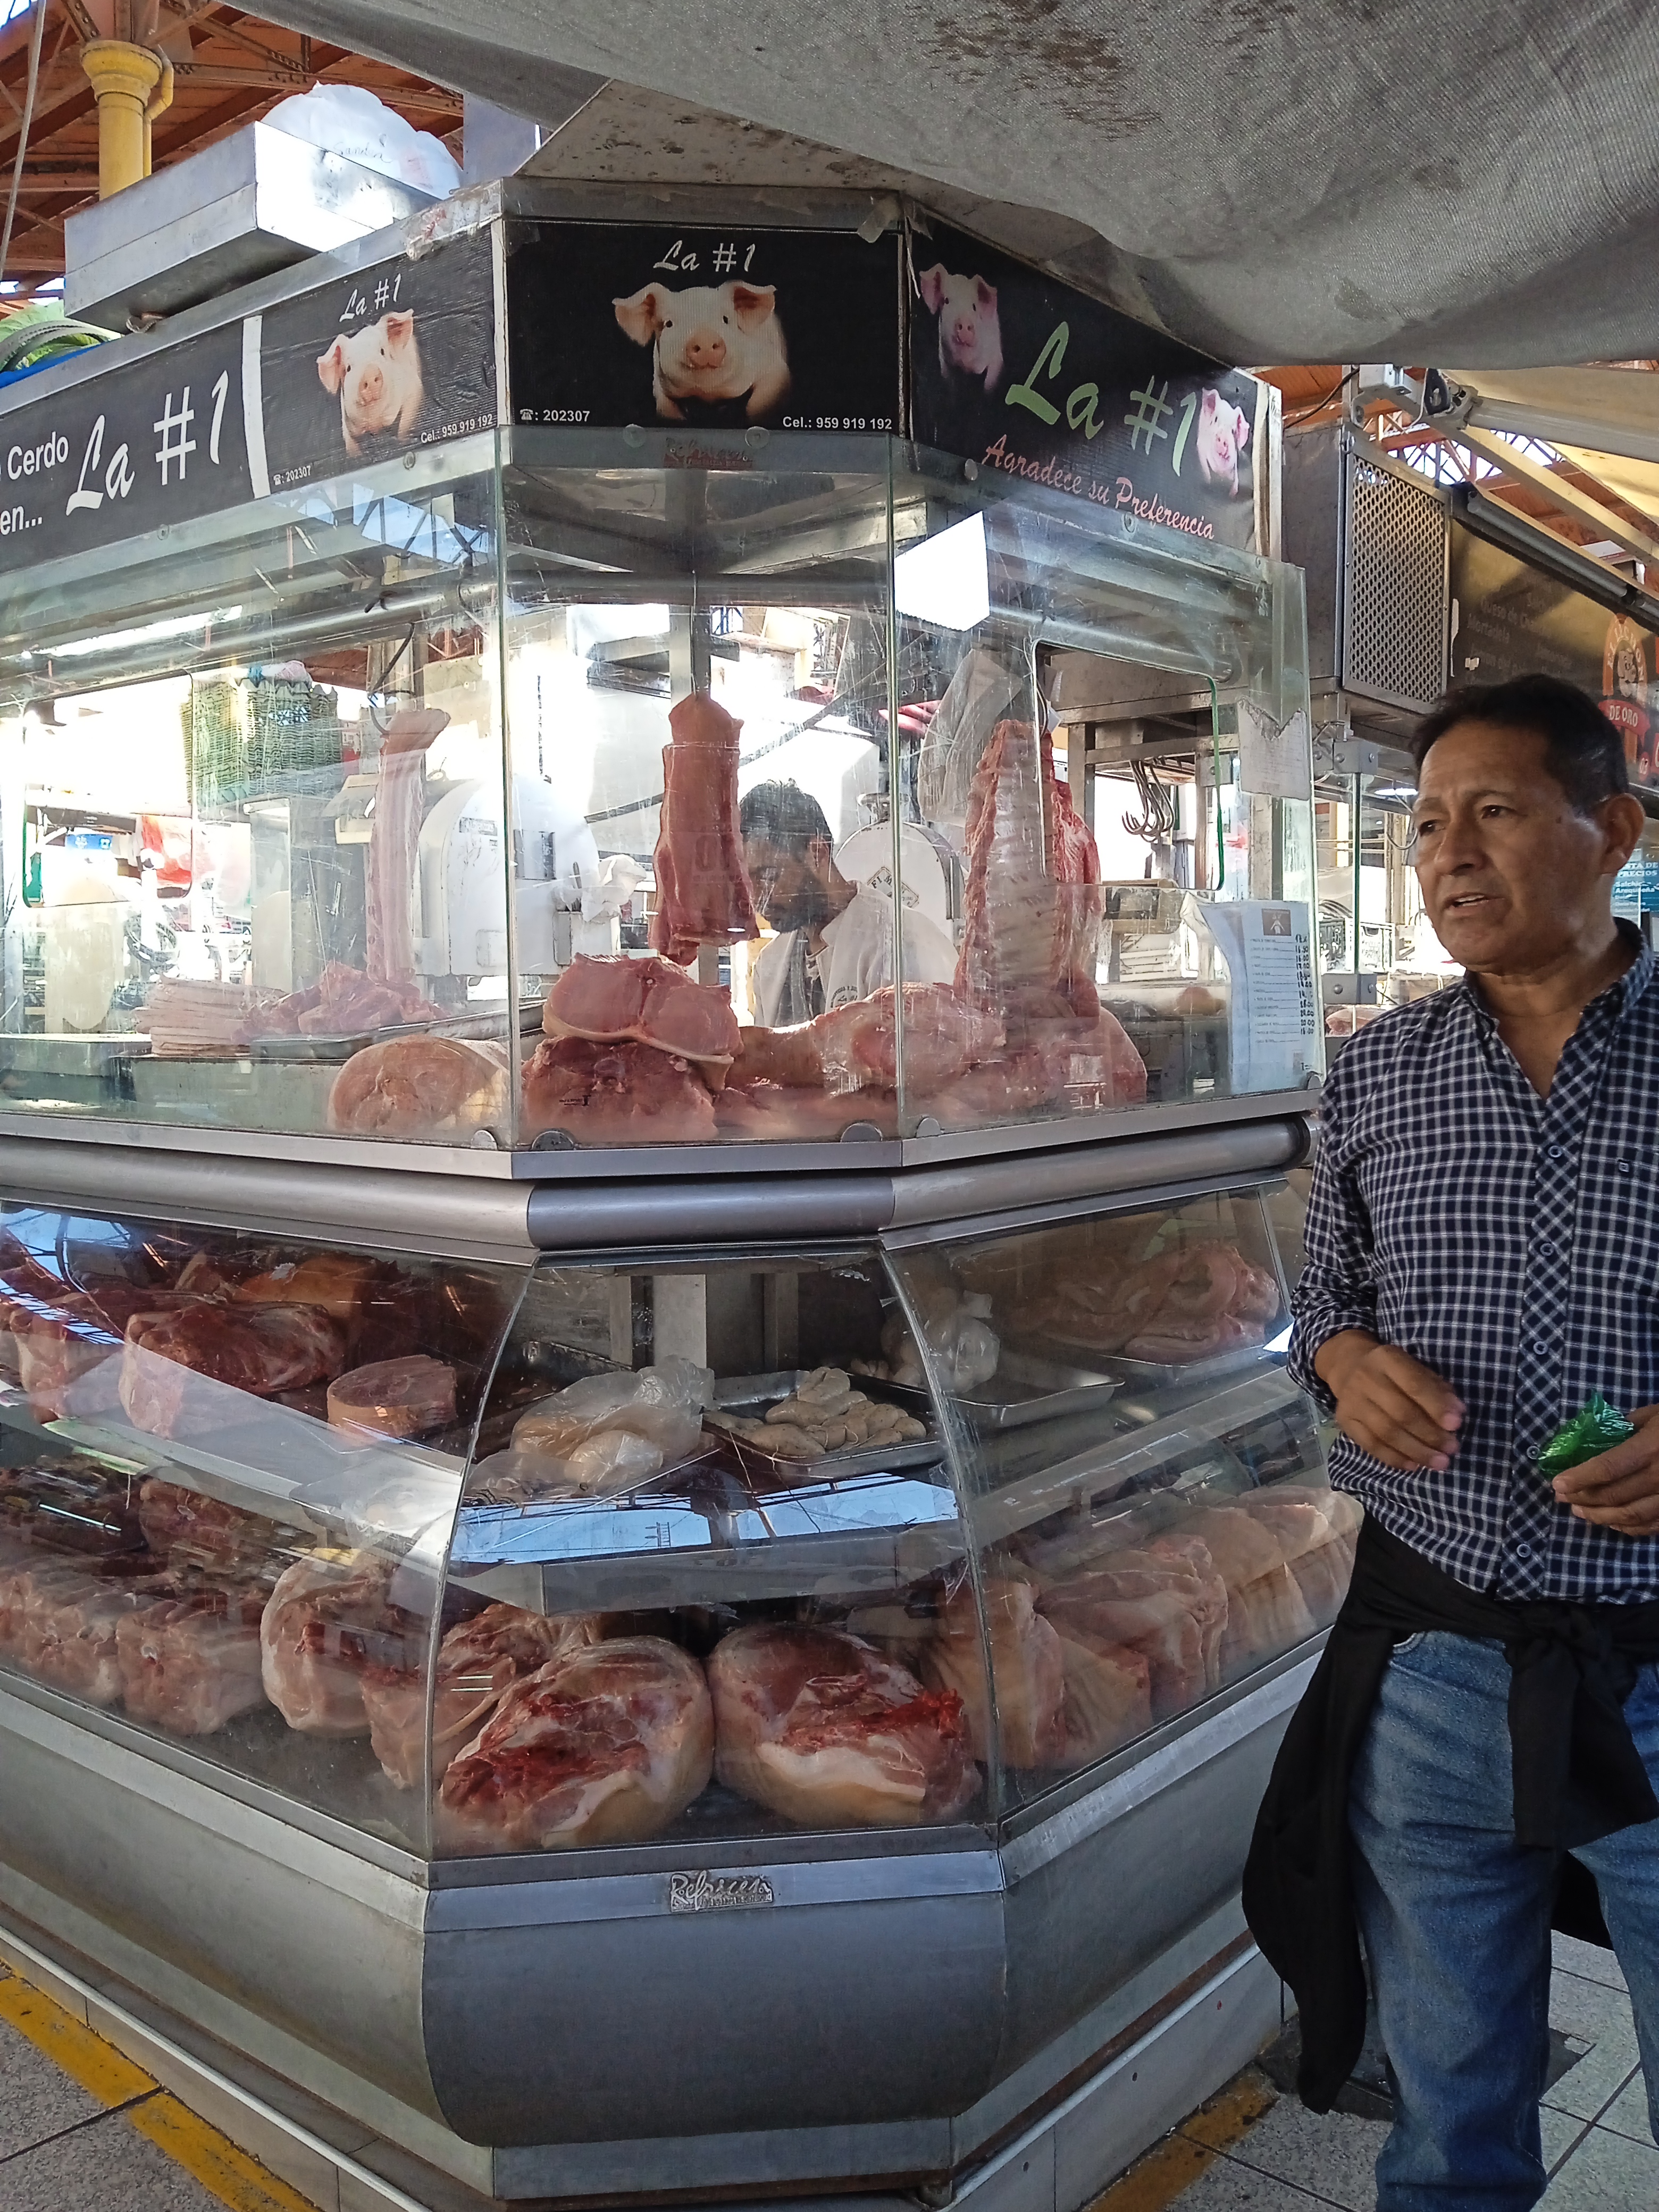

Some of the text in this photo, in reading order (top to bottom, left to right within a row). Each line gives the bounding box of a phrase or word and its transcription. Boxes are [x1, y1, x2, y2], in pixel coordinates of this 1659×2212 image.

[653, 240, 756, 272] La #1
[339, 273, 401, 322] La #1
[1005, 321, 1196, 476] La #1
[421, 414, 492, 443] Cel.: 959 919 192
[543, 409, 590, 422] 202307
[783, 416, 892, 429] Cel.: 959 919 192
[7, 431, 69, 480] Cerdo
[66, 370, 229, 516] La #1
[286, 465, 311, 482] 202307
[982, 434, 1214, 539] Agradece su Preferencia
[0, 506, 43, 535] en...
[1608, 705, 1638, 727] DE ORO
